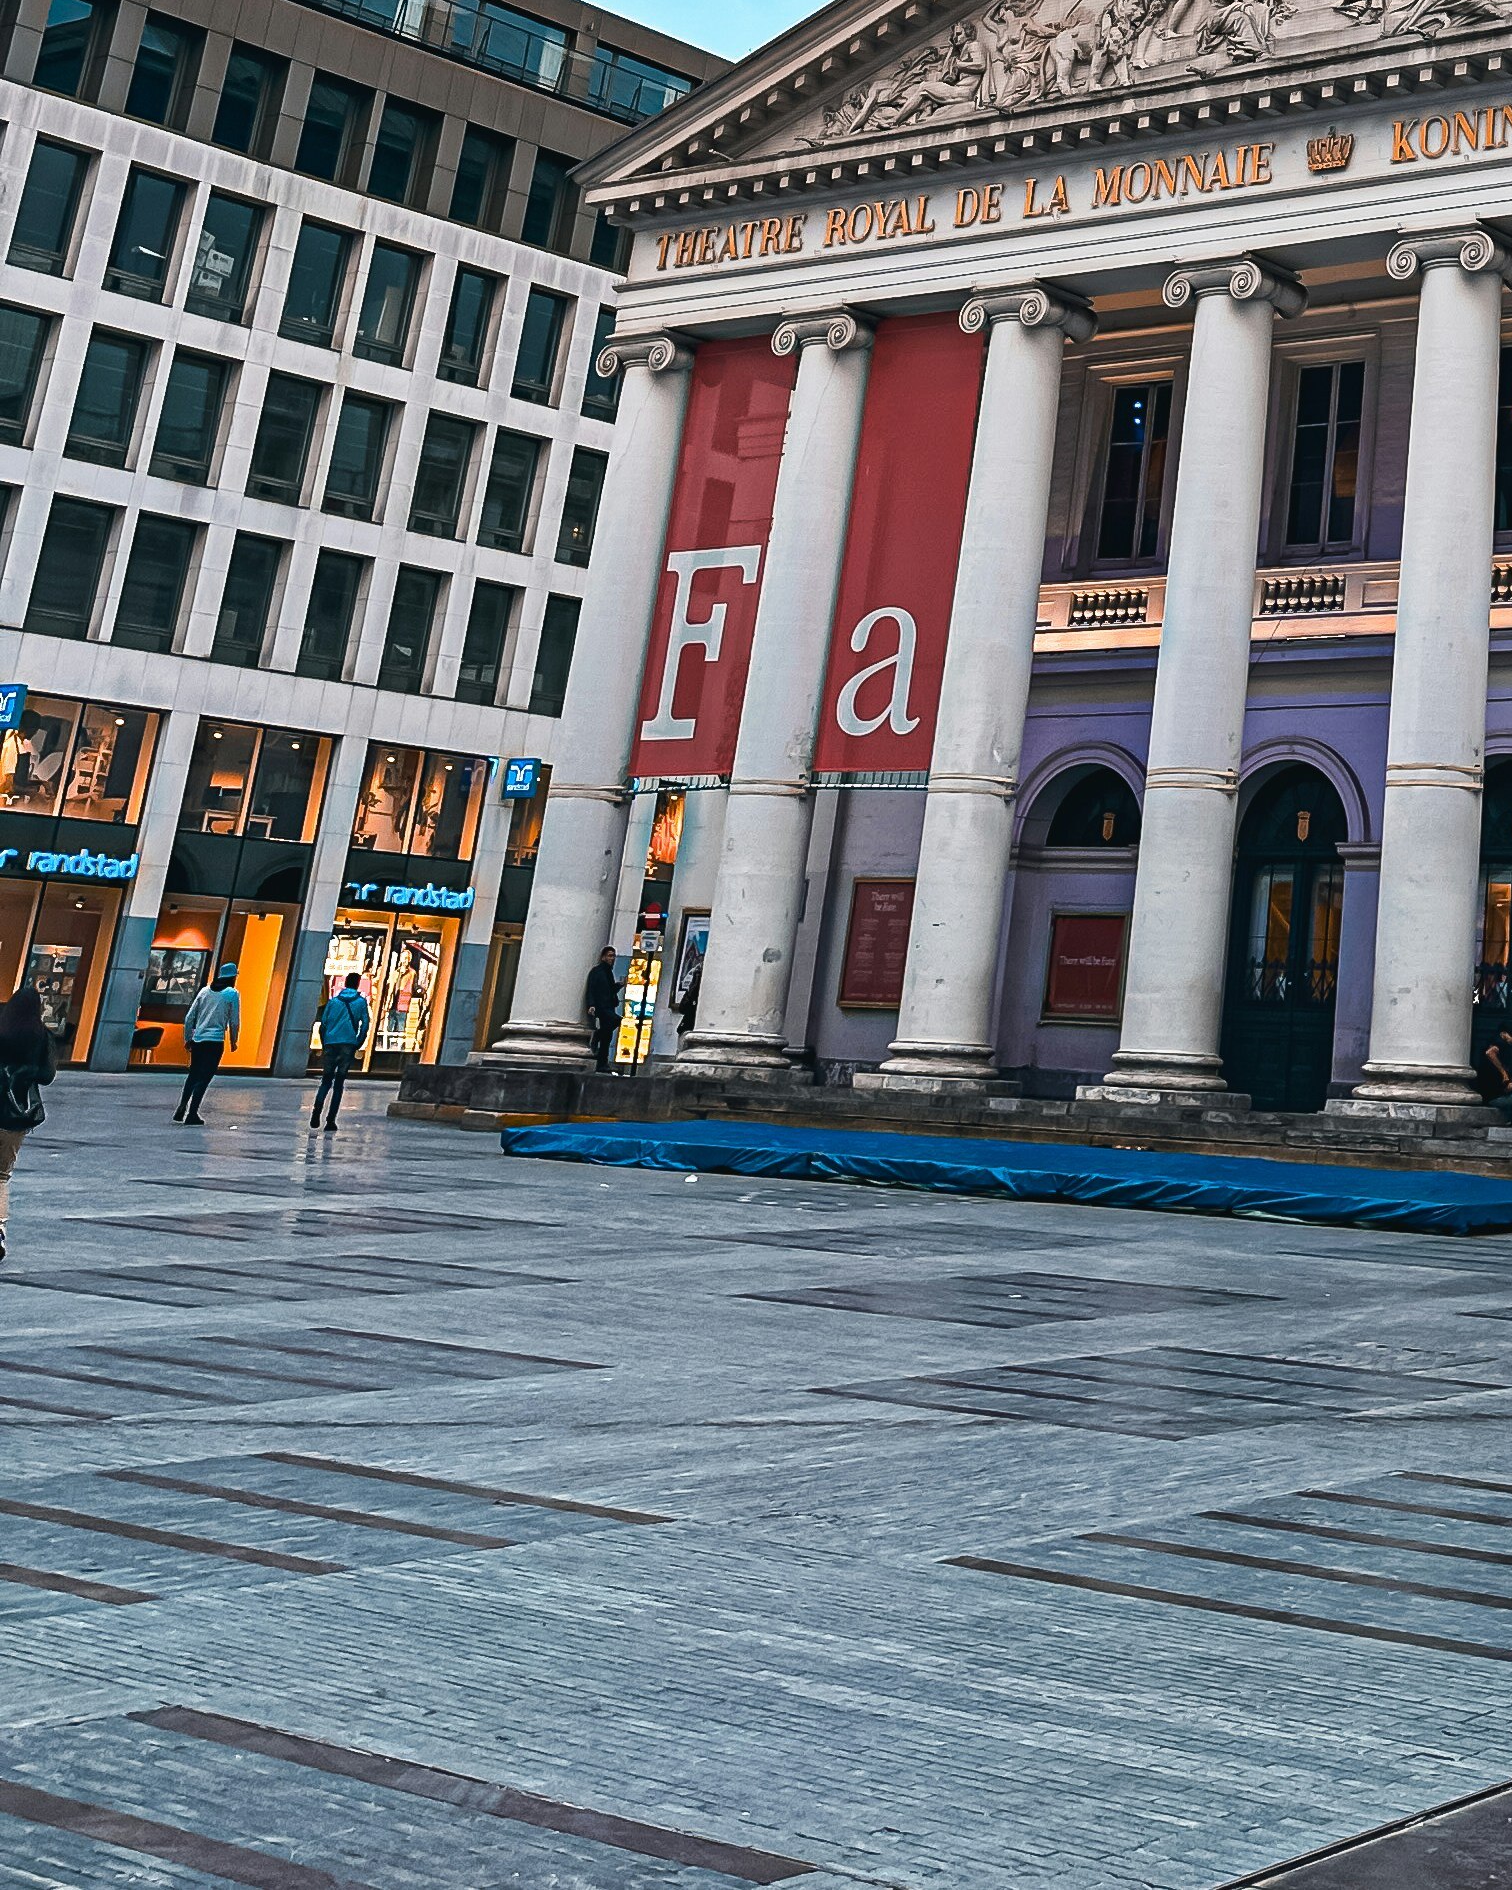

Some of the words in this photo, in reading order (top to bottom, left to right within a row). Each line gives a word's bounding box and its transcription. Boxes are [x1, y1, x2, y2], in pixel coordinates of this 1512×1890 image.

[656, 214, 807, 271] THEATRE
[822, 194, 936, 249] ROYAL
[953, 183, 1003, 228] DE
[1022, 174, 1071, 219] LA
[1091, 142, 1275, 210] MONNAIE
[640, 544, 763, 741] F
[836, 606, 921, 737] a
[27, 849, 140, 879] randstad
[384, 882, 475, 910] randstad
